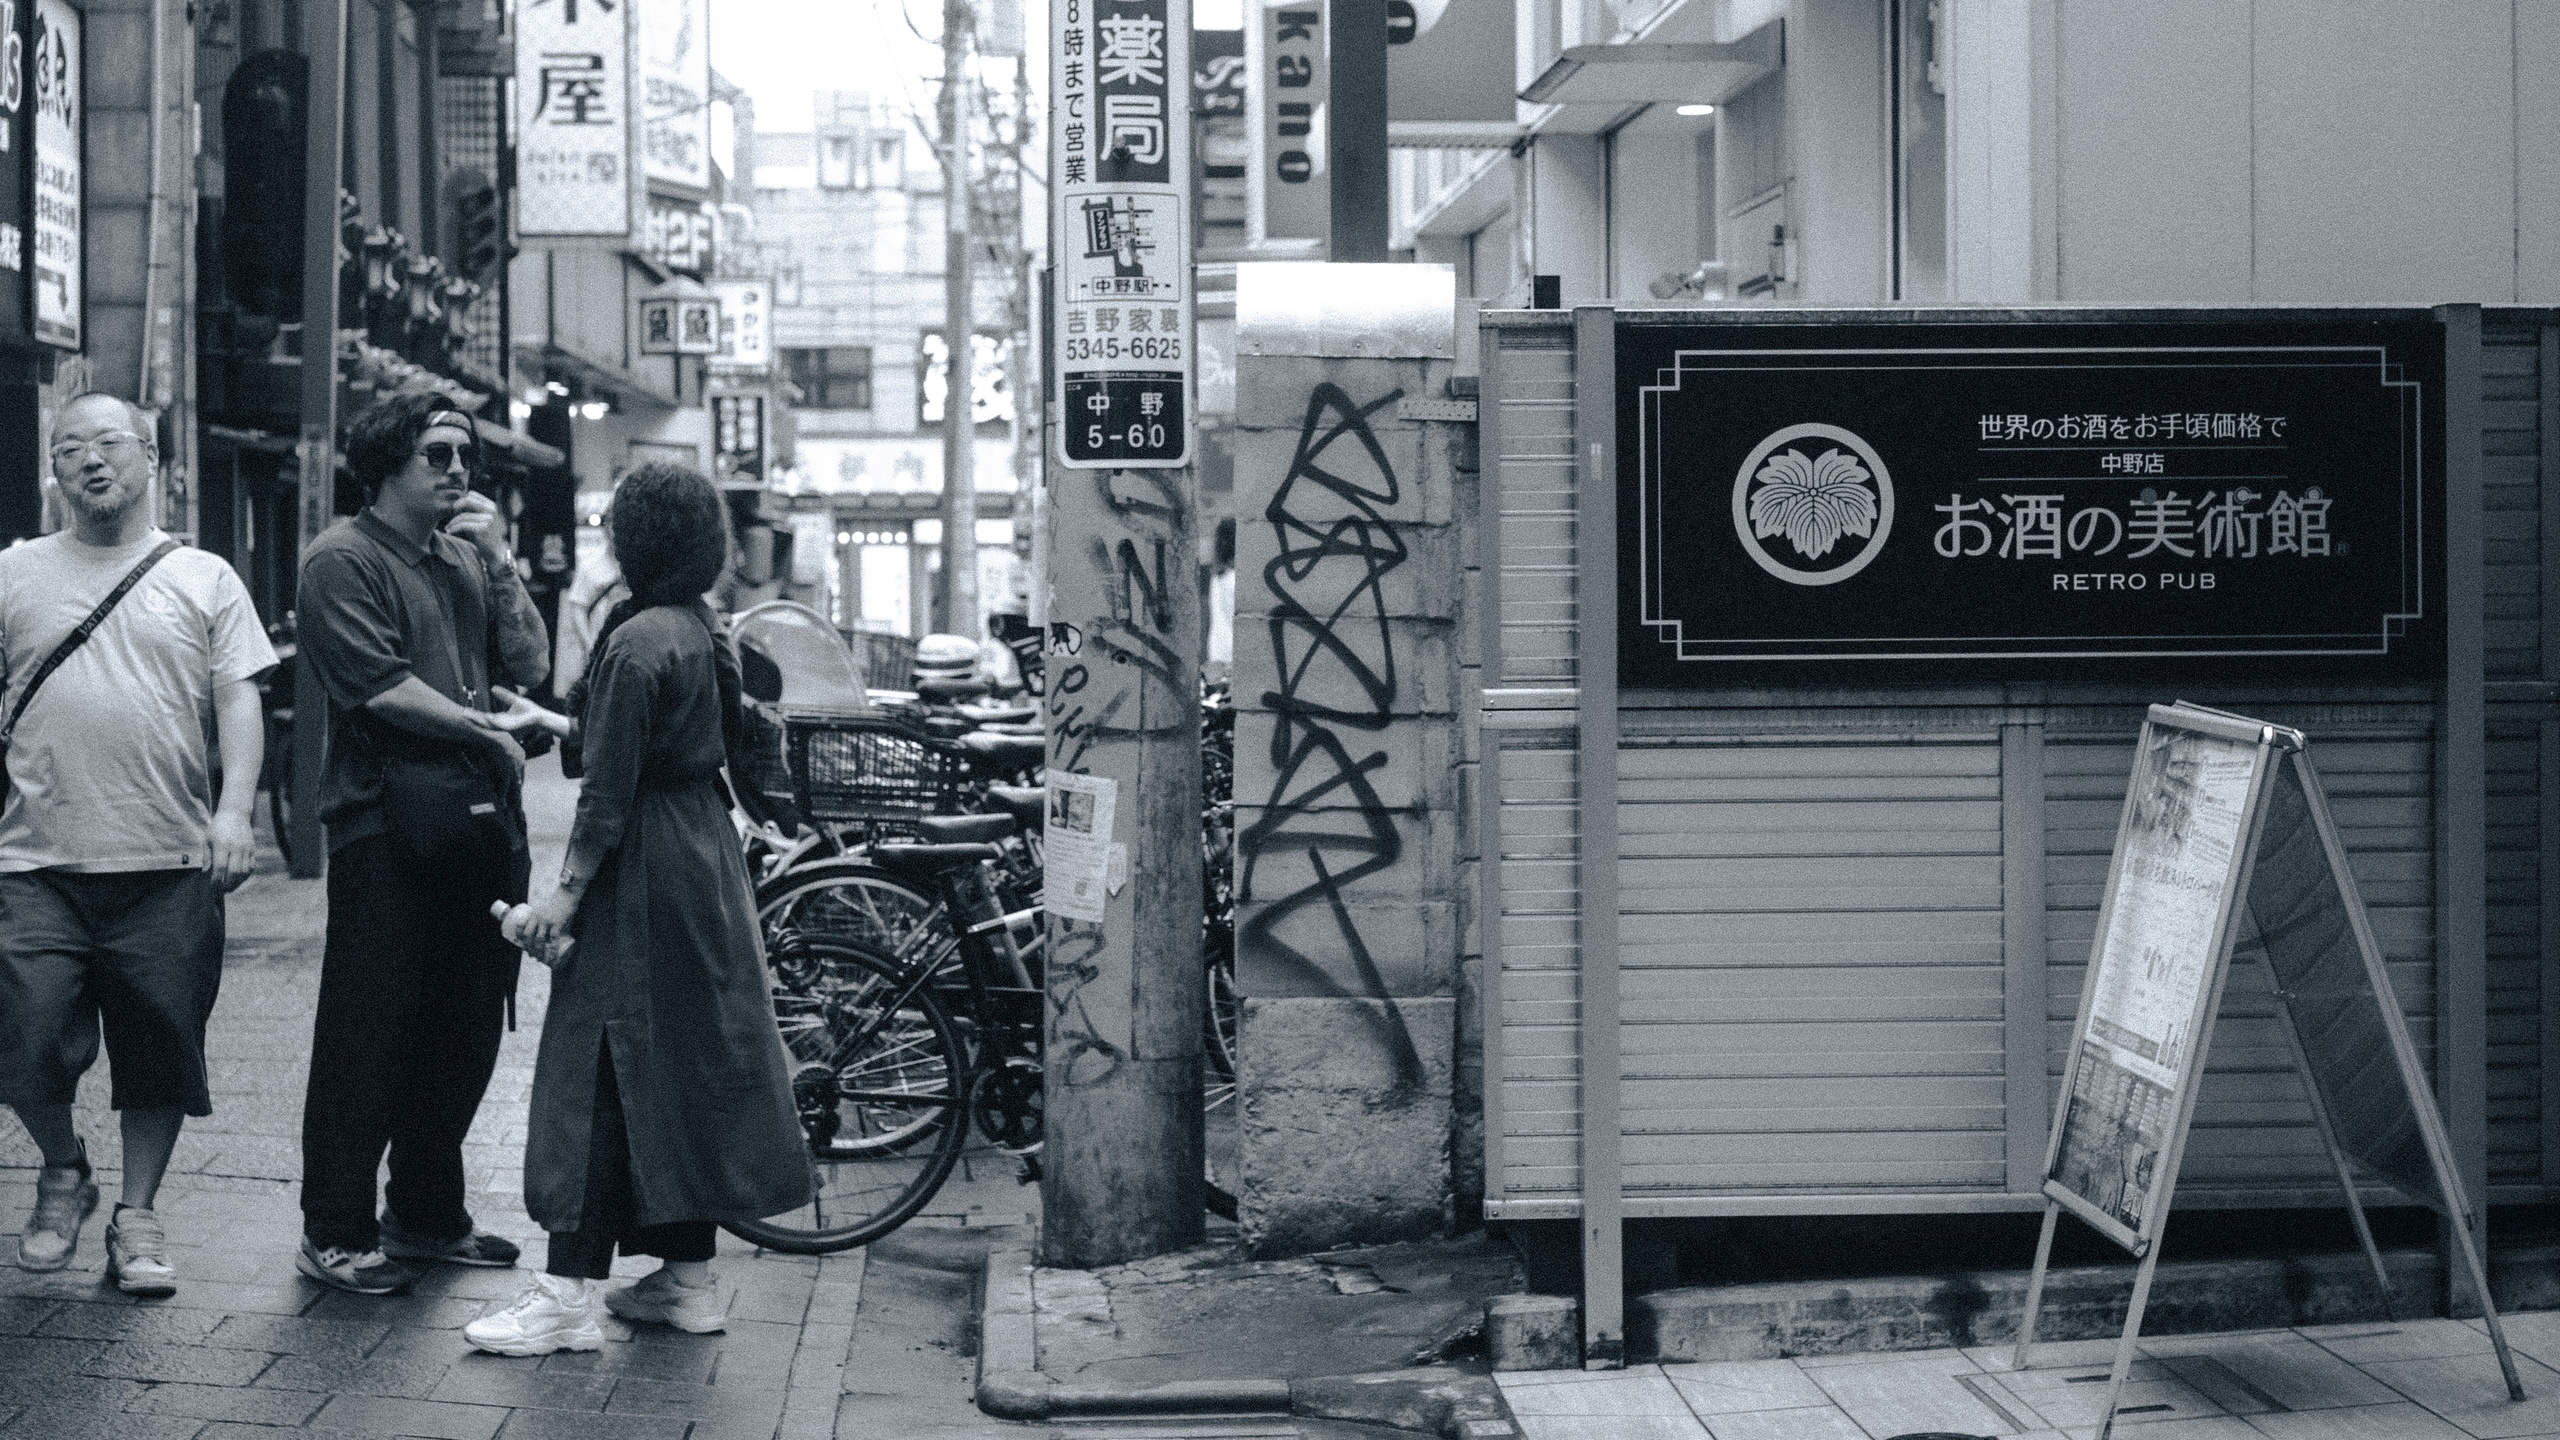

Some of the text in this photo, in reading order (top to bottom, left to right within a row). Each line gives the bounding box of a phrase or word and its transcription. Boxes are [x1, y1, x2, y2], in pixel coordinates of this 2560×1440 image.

[1099, 0, 1165, 165] 薬局
[1095, 278, 1151, 294] 中野駅
[1067, 308, 1180, 334] 吉野家裏
[1066, 337, 1181, 360] 5345-6625
[1087, 424, 1166, 448] 5-60
[1977, 413, 2287, 440] 世界のお酒をお手頃価格で
[2100, 453, 2165, 474] 中野店
[1932, 490, 2333, 560] お酒の美術館
[2052, 573, 2217, 591] RETRO PUB
